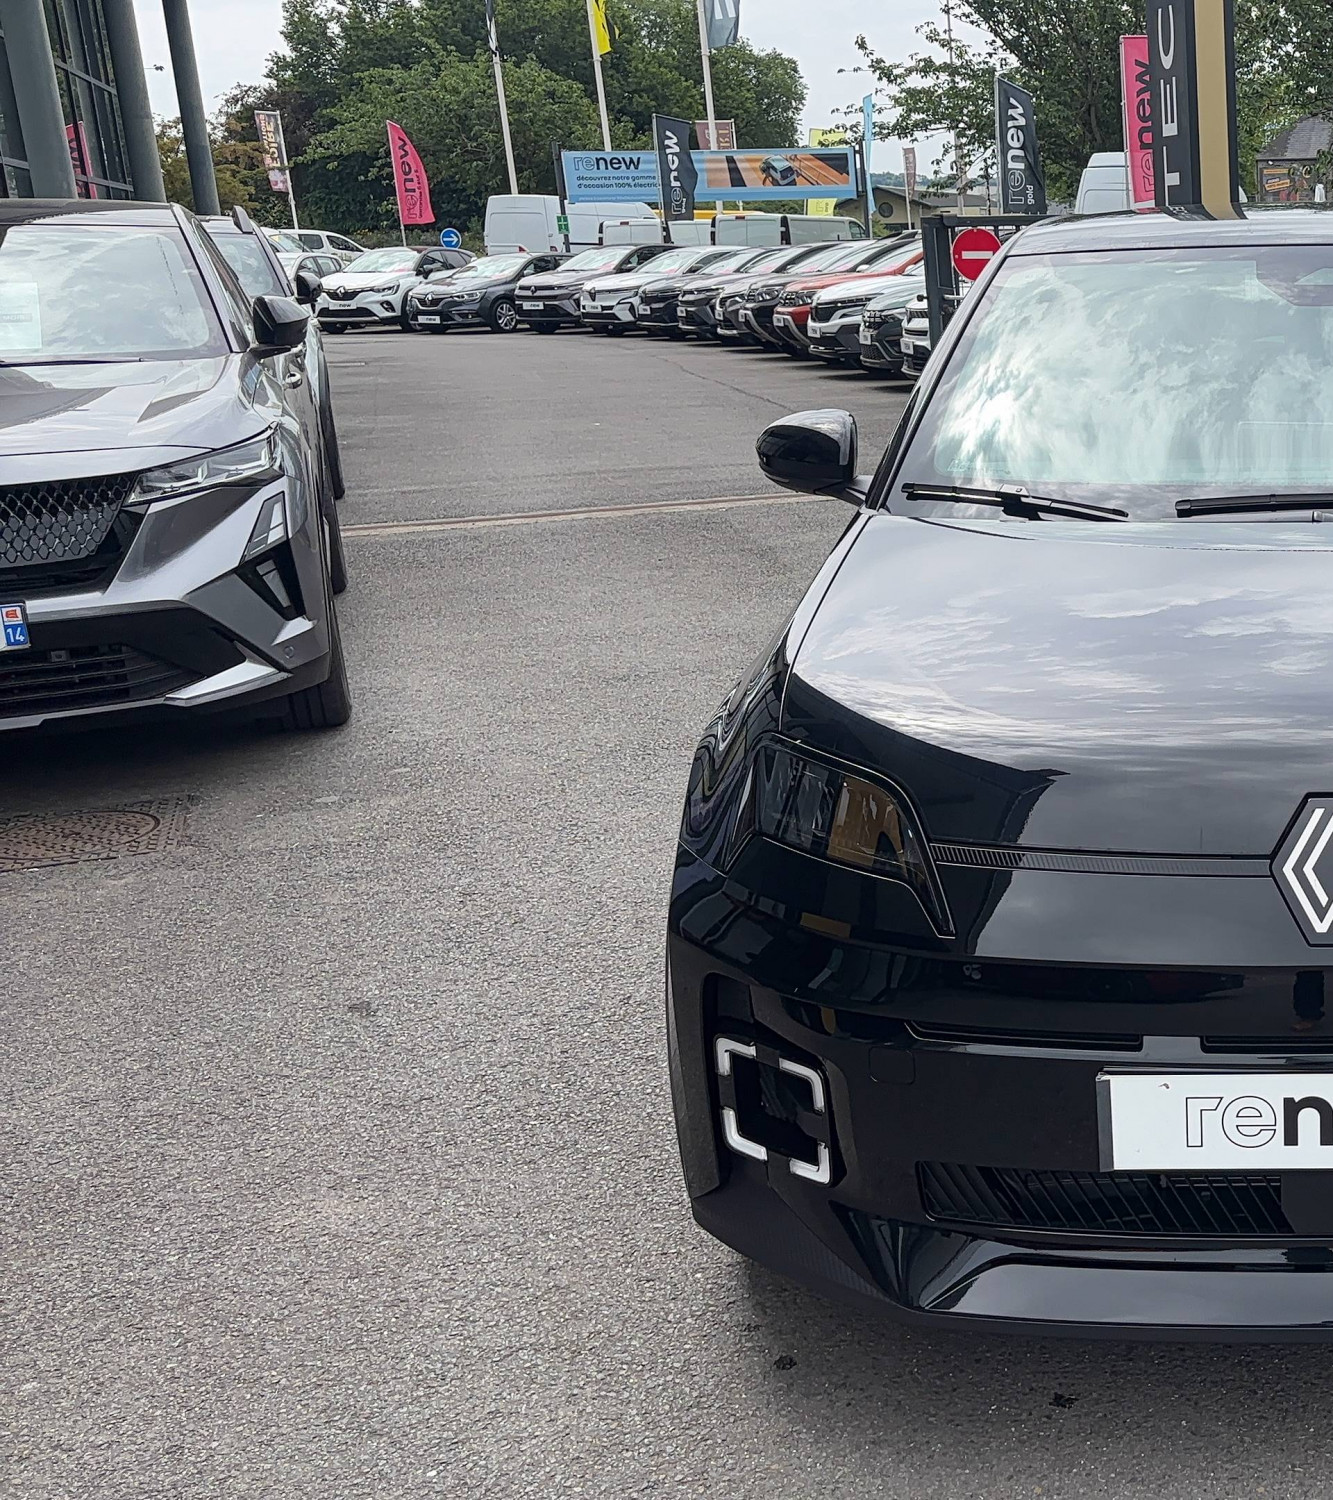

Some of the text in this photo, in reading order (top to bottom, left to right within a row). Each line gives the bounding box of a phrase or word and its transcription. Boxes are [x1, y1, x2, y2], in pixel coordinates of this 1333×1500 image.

[397, 135, 419, 219] renew
[573, 156, 641, 171] renew
[664, 130, 683, 215] renew
[1006, 97, 1026, 205] renew
[1026, 184, 1035, 205] gold
[6, 626, 25, 643] 14
